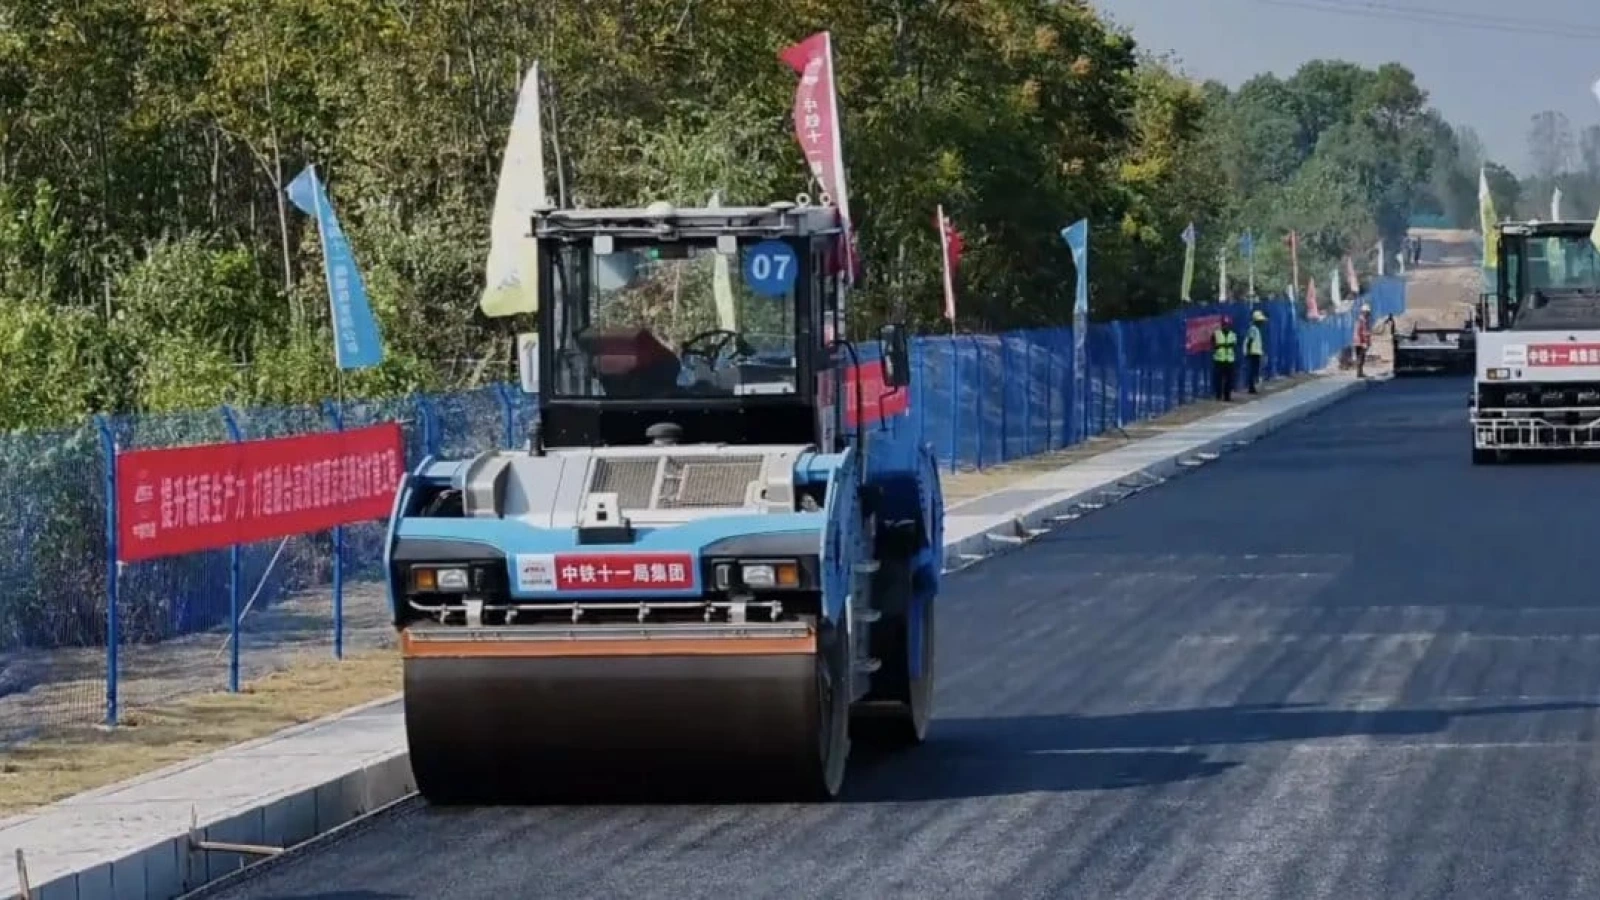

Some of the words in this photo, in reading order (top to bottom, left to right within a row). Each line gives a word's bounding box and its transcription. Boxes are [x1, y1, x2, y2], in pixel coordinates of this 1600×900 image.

[752, 254, 791, 280] 07
[562, 563, 686, 583] 中铁十一局集团
